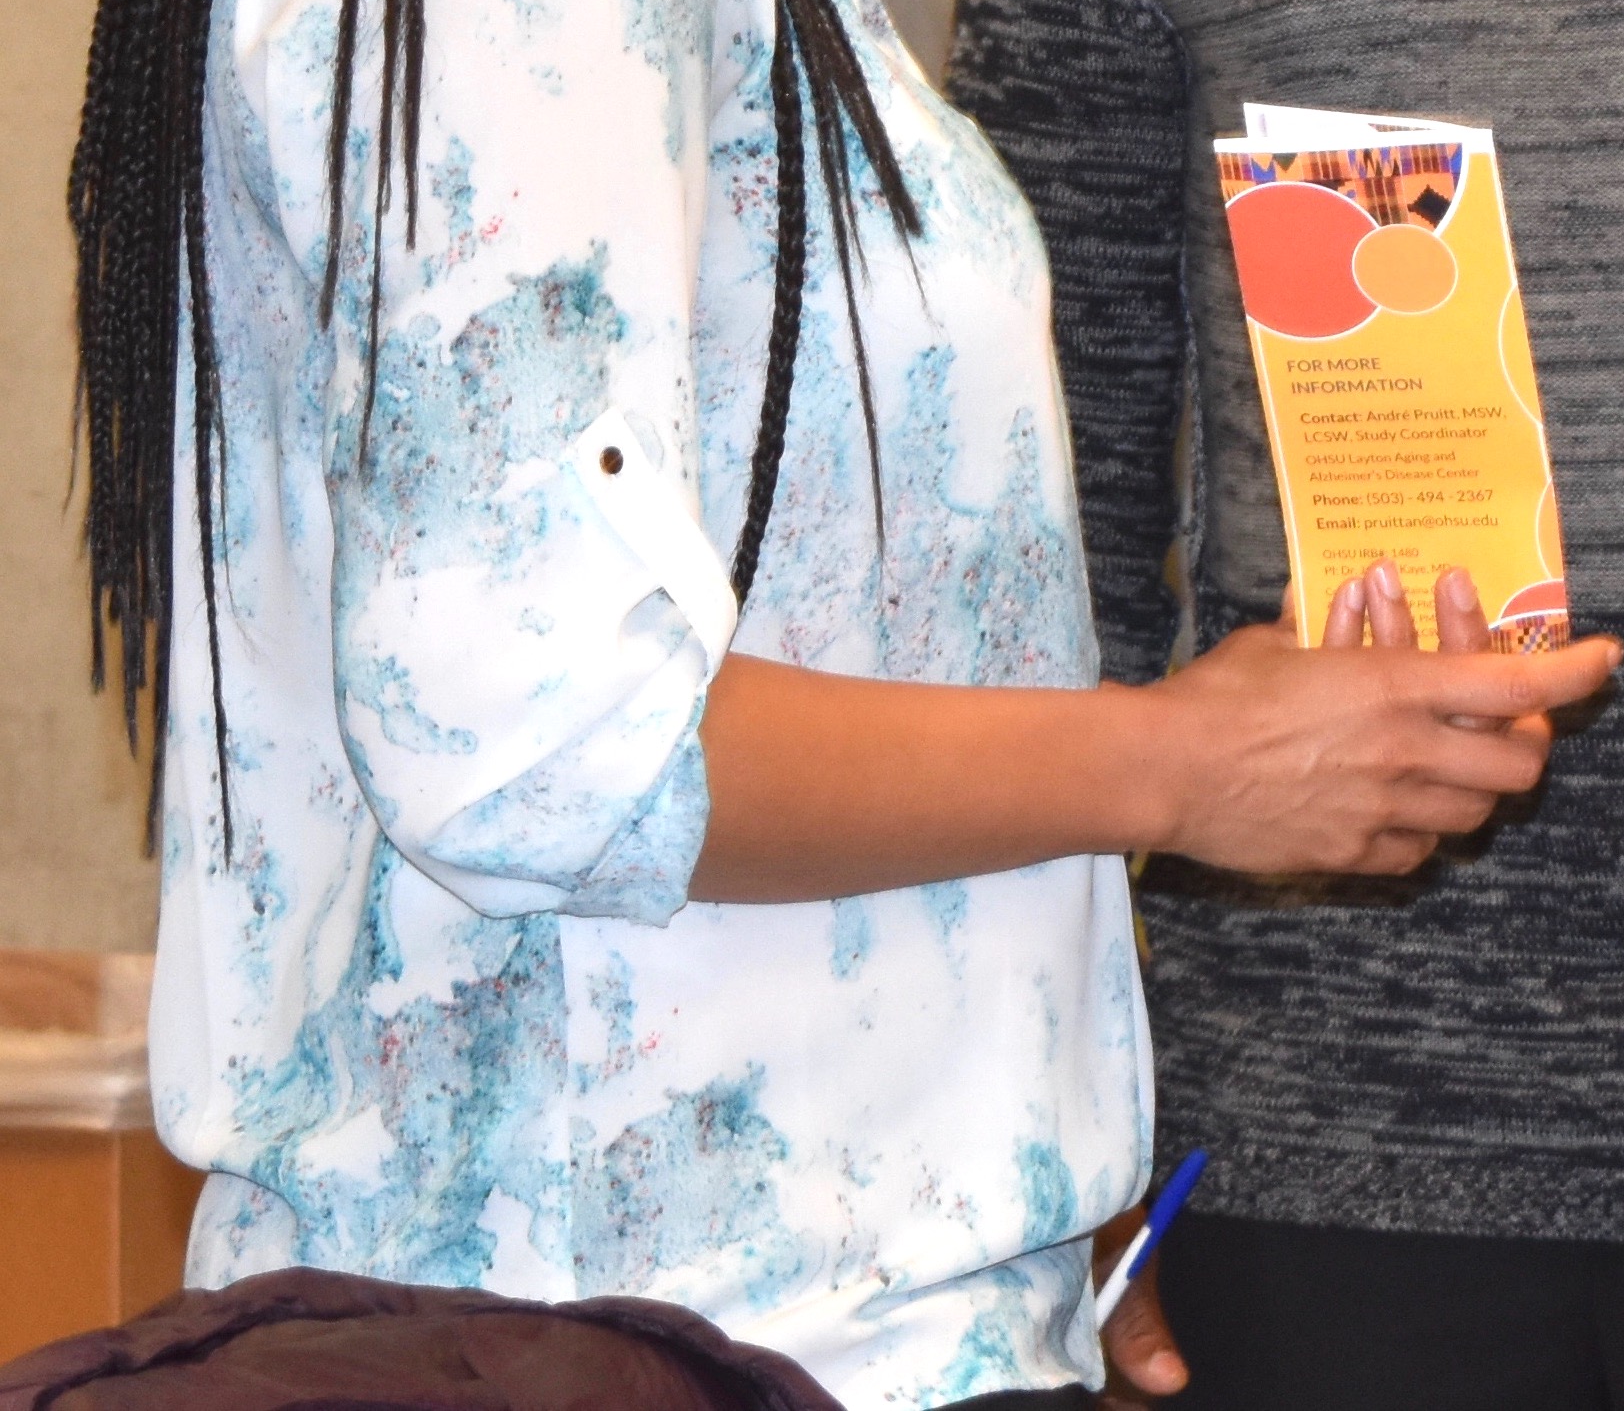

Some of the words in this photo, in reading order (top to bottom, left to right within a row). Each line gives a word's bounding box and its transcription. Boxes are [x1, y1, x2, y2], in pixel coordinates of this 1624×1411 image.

[1286, 359, 1324, 373] FOR
[1326, 357, 1382, 372] MORE
[1291, 377, 1423, 395] INFORMATION
[1300, 412, 1364, 424] Contact:
[1366, 409, 1411, 422] André
[1355, 429, 1397, 443] Study
[1400, 427, 1488, 440] Coordinator
[1305, 454, 1346, 465] OHSU
[1348, 453, 1393, 465] Layton
[1395, 451, 1431, 464] Aging
[1433, 450, 1456, 462] and
[1385, 469, 1434, 481] Disease
[1436, 467, 1480, 479] Center
[1312, 493, 1364, 506] Phone:
[1366, 491, 1405, 507] (503)
[1416, 491, 1445, 503] 494
[1456, 489, 1494, 502] 2367
[1316, 516, 1361, 530] Email:
[1364, 513, 1499, 530] pruittan@ohsu.edu
